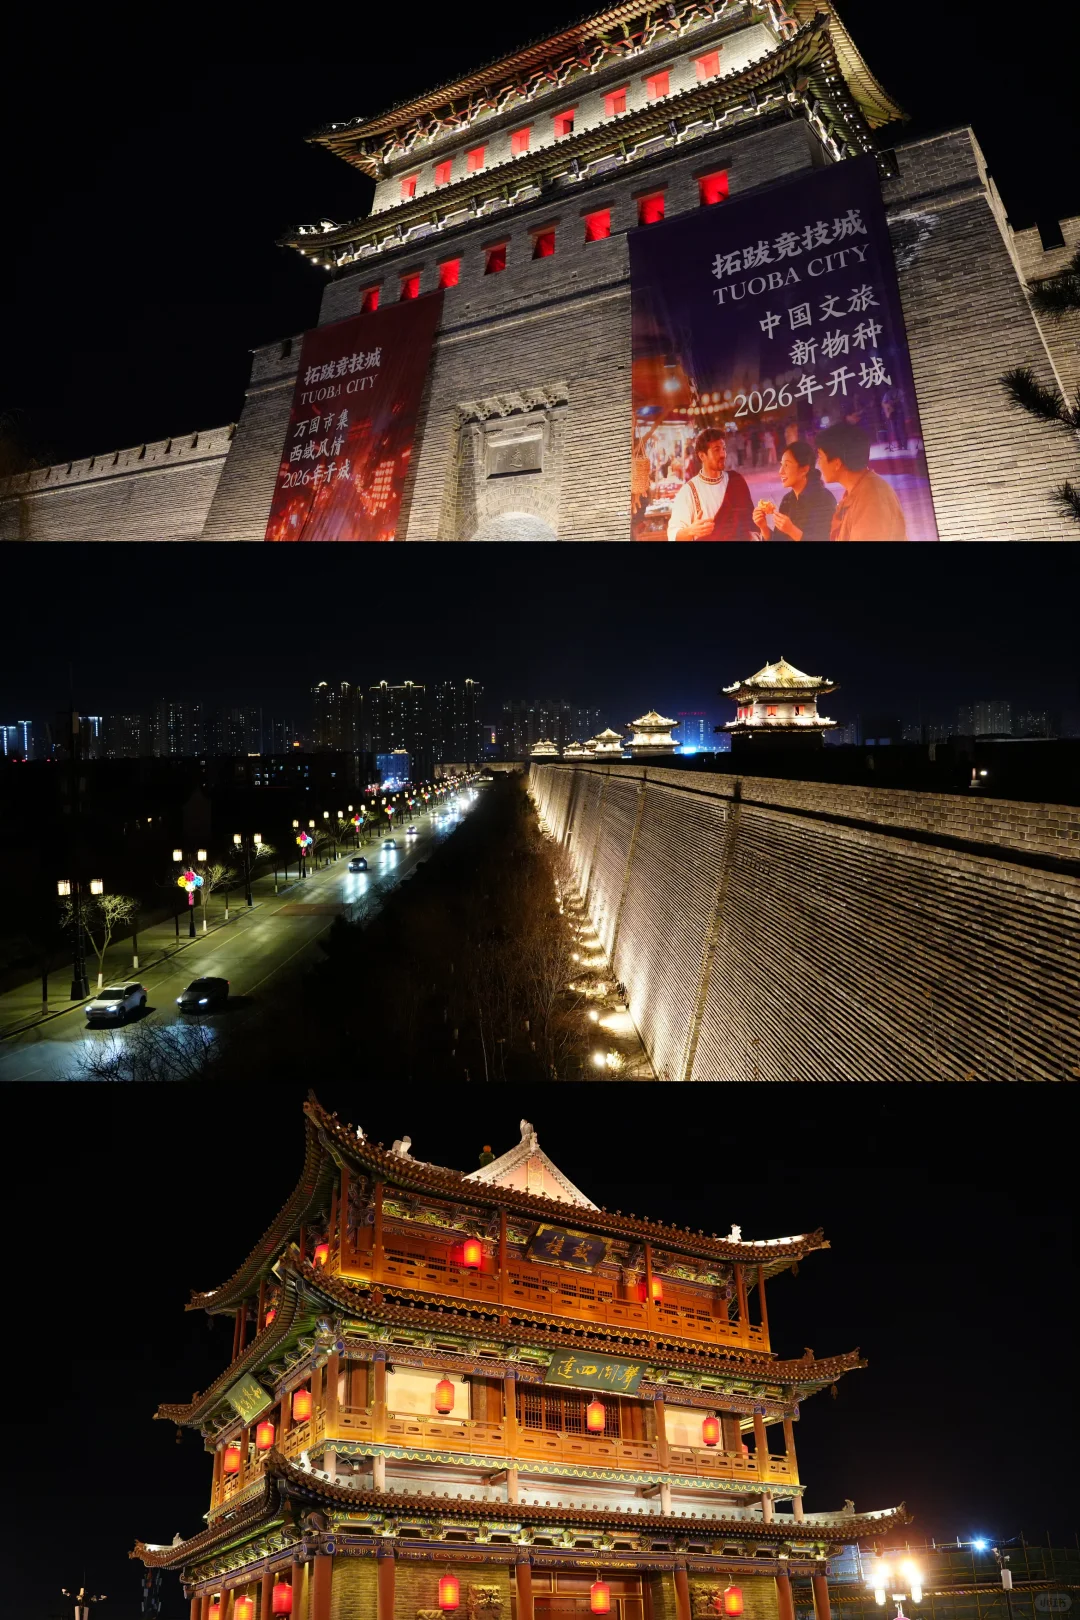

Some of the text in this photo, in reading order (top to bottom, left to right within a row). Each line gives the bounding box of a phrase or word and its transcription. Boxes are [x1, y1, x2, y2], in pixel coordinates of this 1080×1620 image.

[711, 209, 867, 279] 拓跋竞技城
[713, 244, 869, 305] TUOBA CITY
[759, 284, 880, 339] 中国文旅
[789, 319, 883, 366] 新物种
[304, 347, 381, 385] 拓跋竞技城
[734, 356, 892, 418] 2026年开城
[301, 374, 378, 406] TUOBA CITY
[294, 409, 349, 438] 万国市集
[289, 437, 345, 462] 西域风情
[282, 458, 351, 489] 2026年开城
